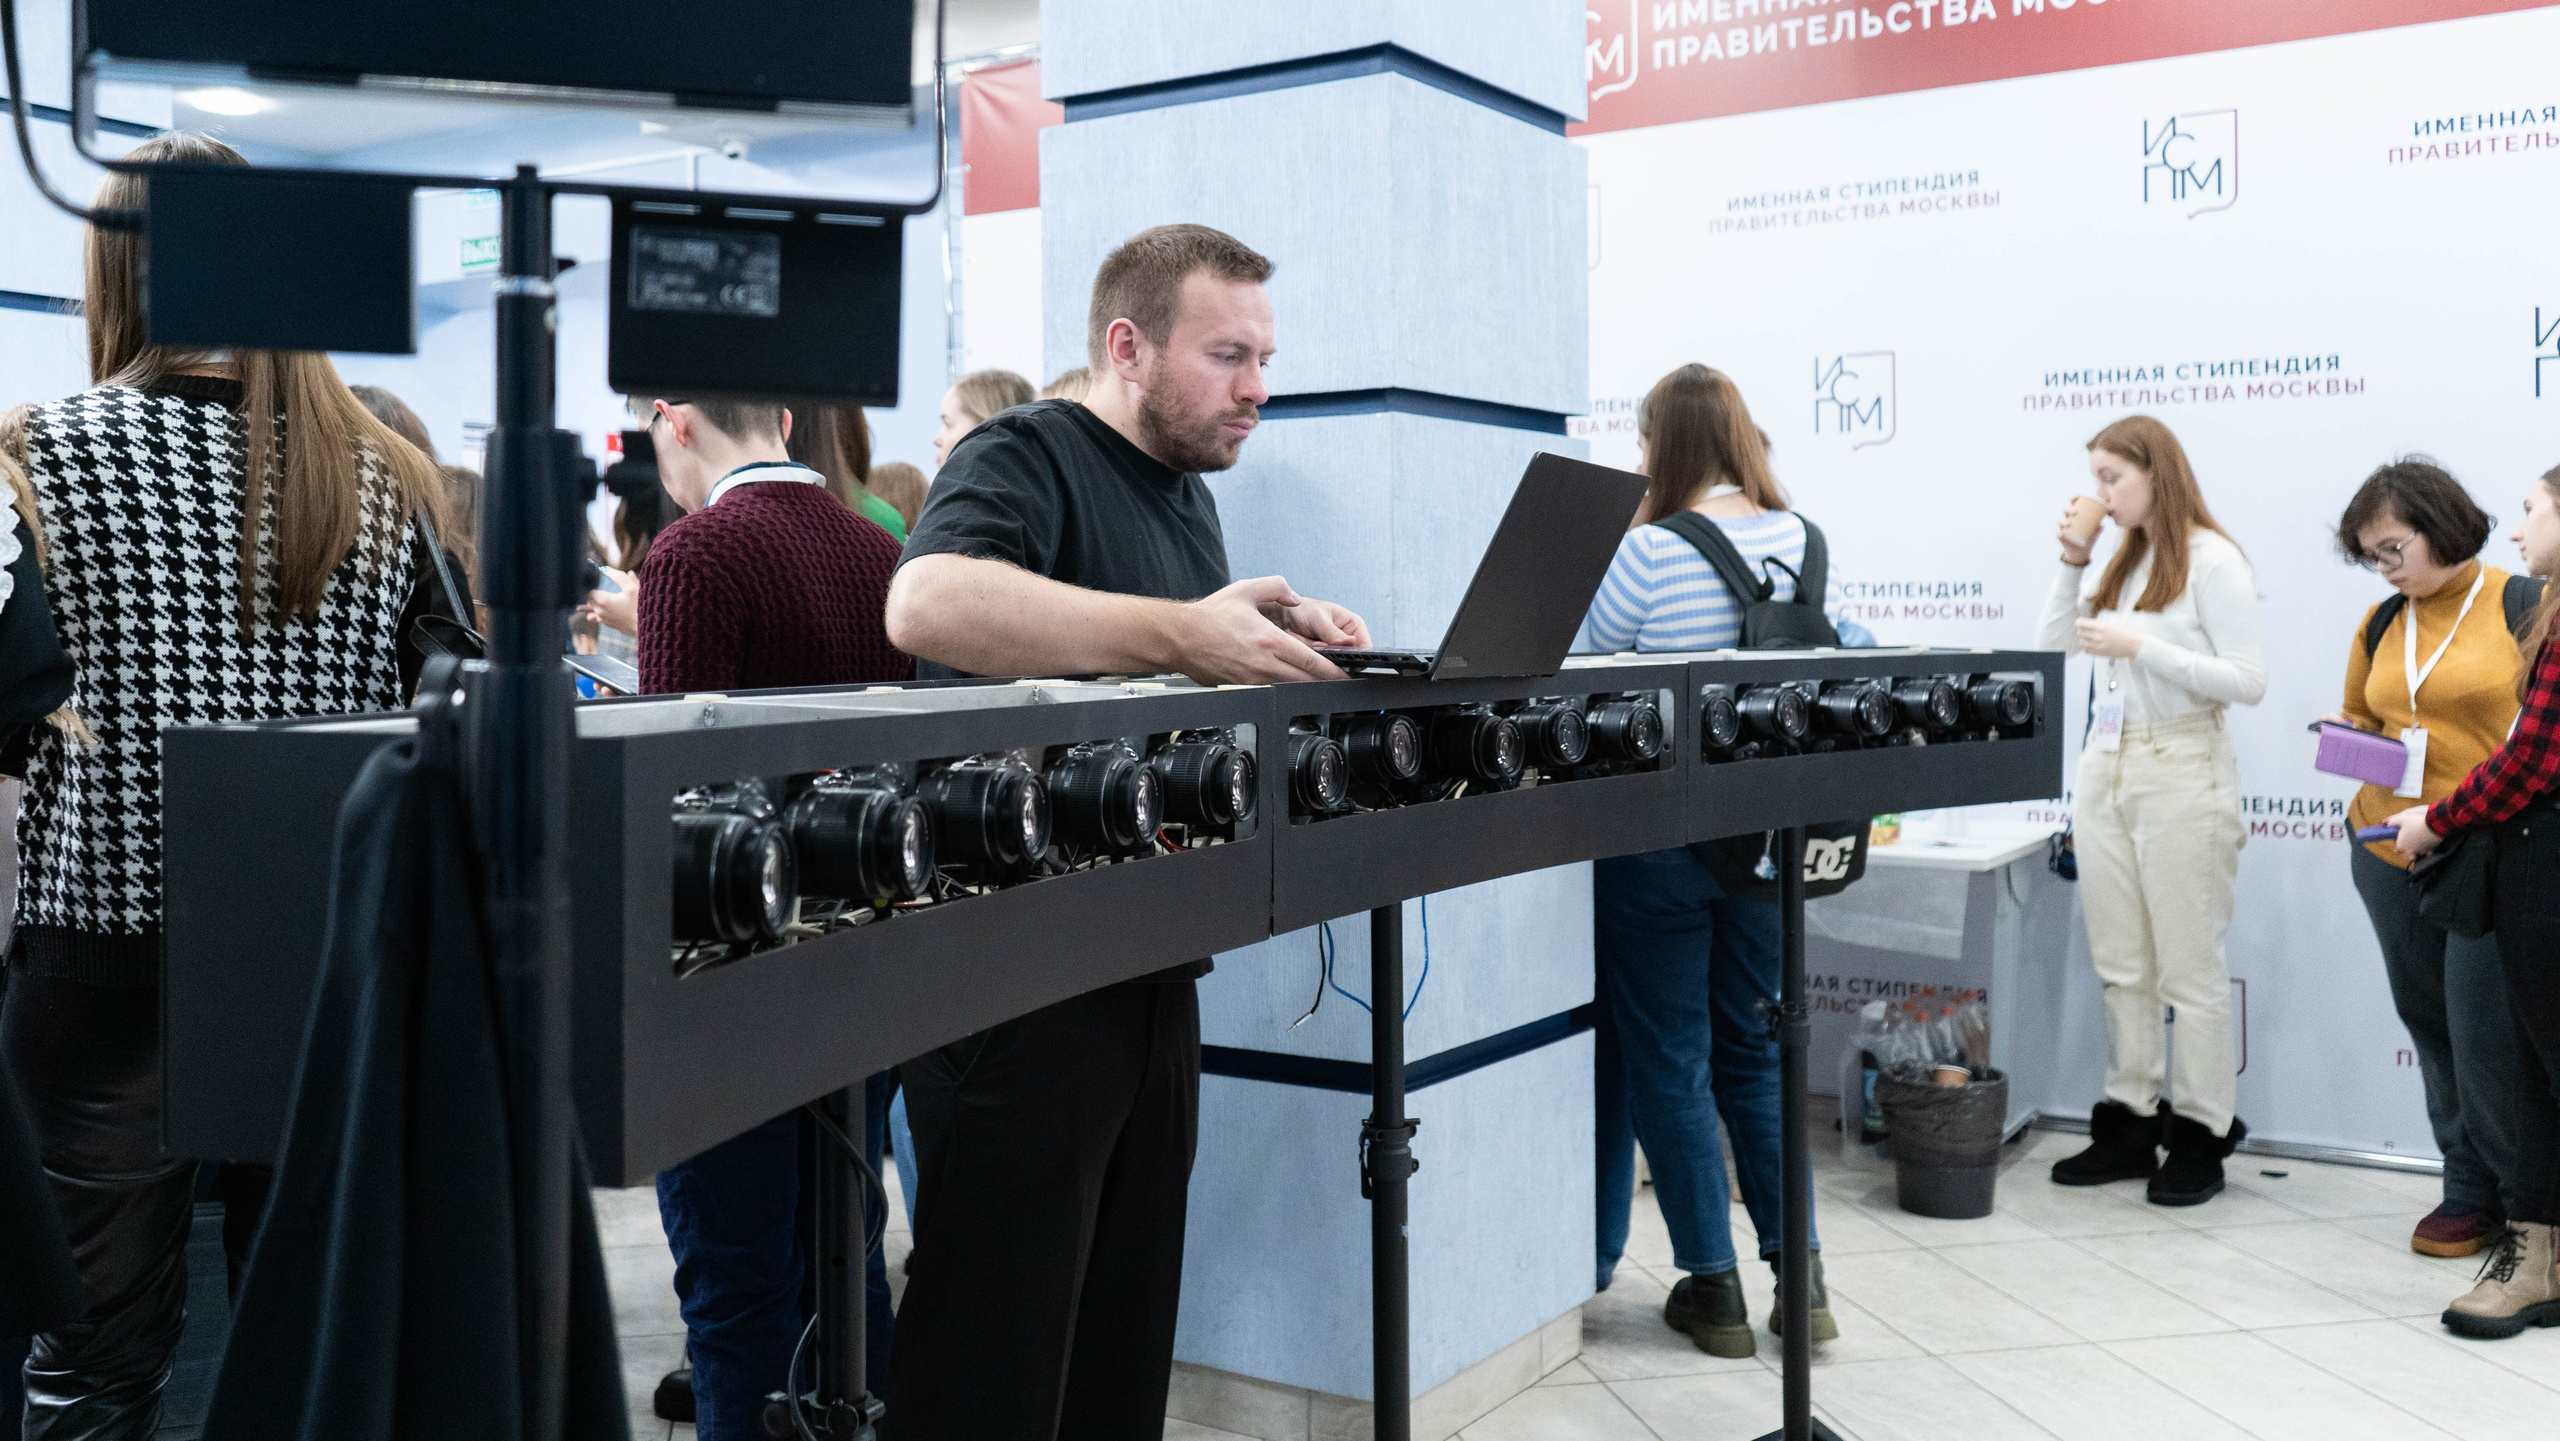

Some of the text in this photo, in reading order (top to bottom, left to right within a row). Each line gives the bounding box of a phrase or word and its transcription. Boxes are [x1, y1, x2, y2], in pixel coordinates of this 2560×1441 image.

[1653, 0, 1998, 70] ПРАВИТЕЛЬСТВА
[2414, 105, 2556, 137] ИМЕННАЯ
[1727, 168, 1980, 213] ИМЕННАЯ СТИПЕНДИЯ
[1708, 191, 2001, 235] ПРАВИТЕЛЬСТВА МОСКВЫ
[2044, 353, 2340, 388] ИМЕННАЯ СТИПЕНДИЯ
[2023, 376, 2366, 411] ПРАВИТЕЛЬСТВА МОСКВЫ
[1843, 580, 1983, 599] СТИПЕНДИЯ
[1904, 602, 2004, 620] МОСКВЫ
